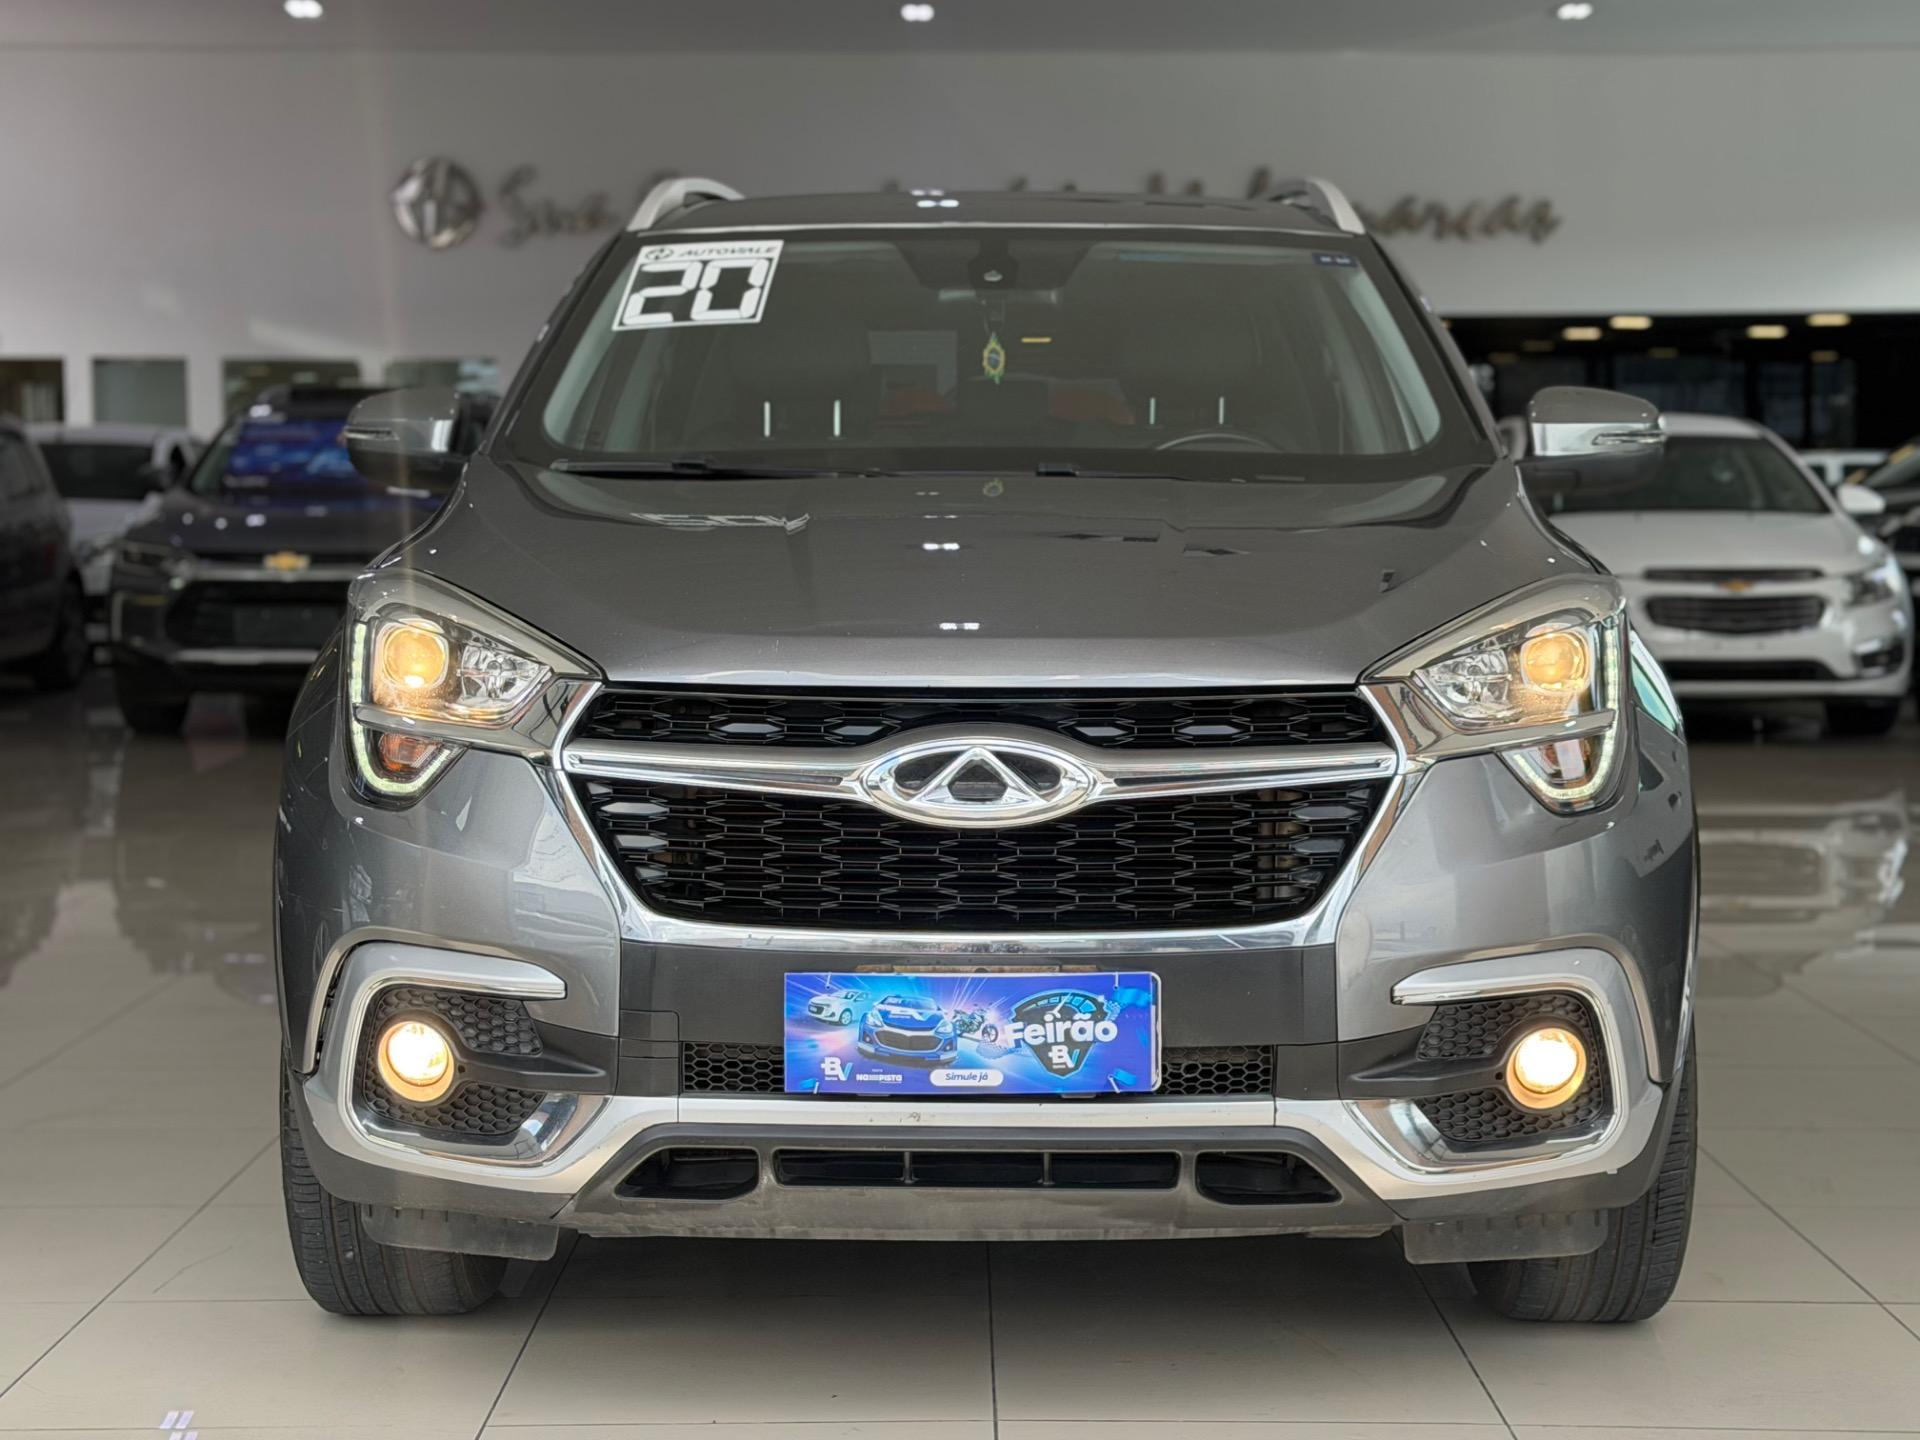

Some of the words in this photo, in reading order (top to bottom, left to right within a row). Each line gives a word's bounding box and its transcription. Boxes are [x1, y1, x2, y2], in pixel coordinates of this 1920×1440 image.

[677, 245, 778, 258] AUTOVALE
[622, 260, 769, 325] 20
[1004, 1012, 1118, 1049] Feirão
[945, 1072, 977, 1081] Simule
[977, 1072, 989, 1083] já
